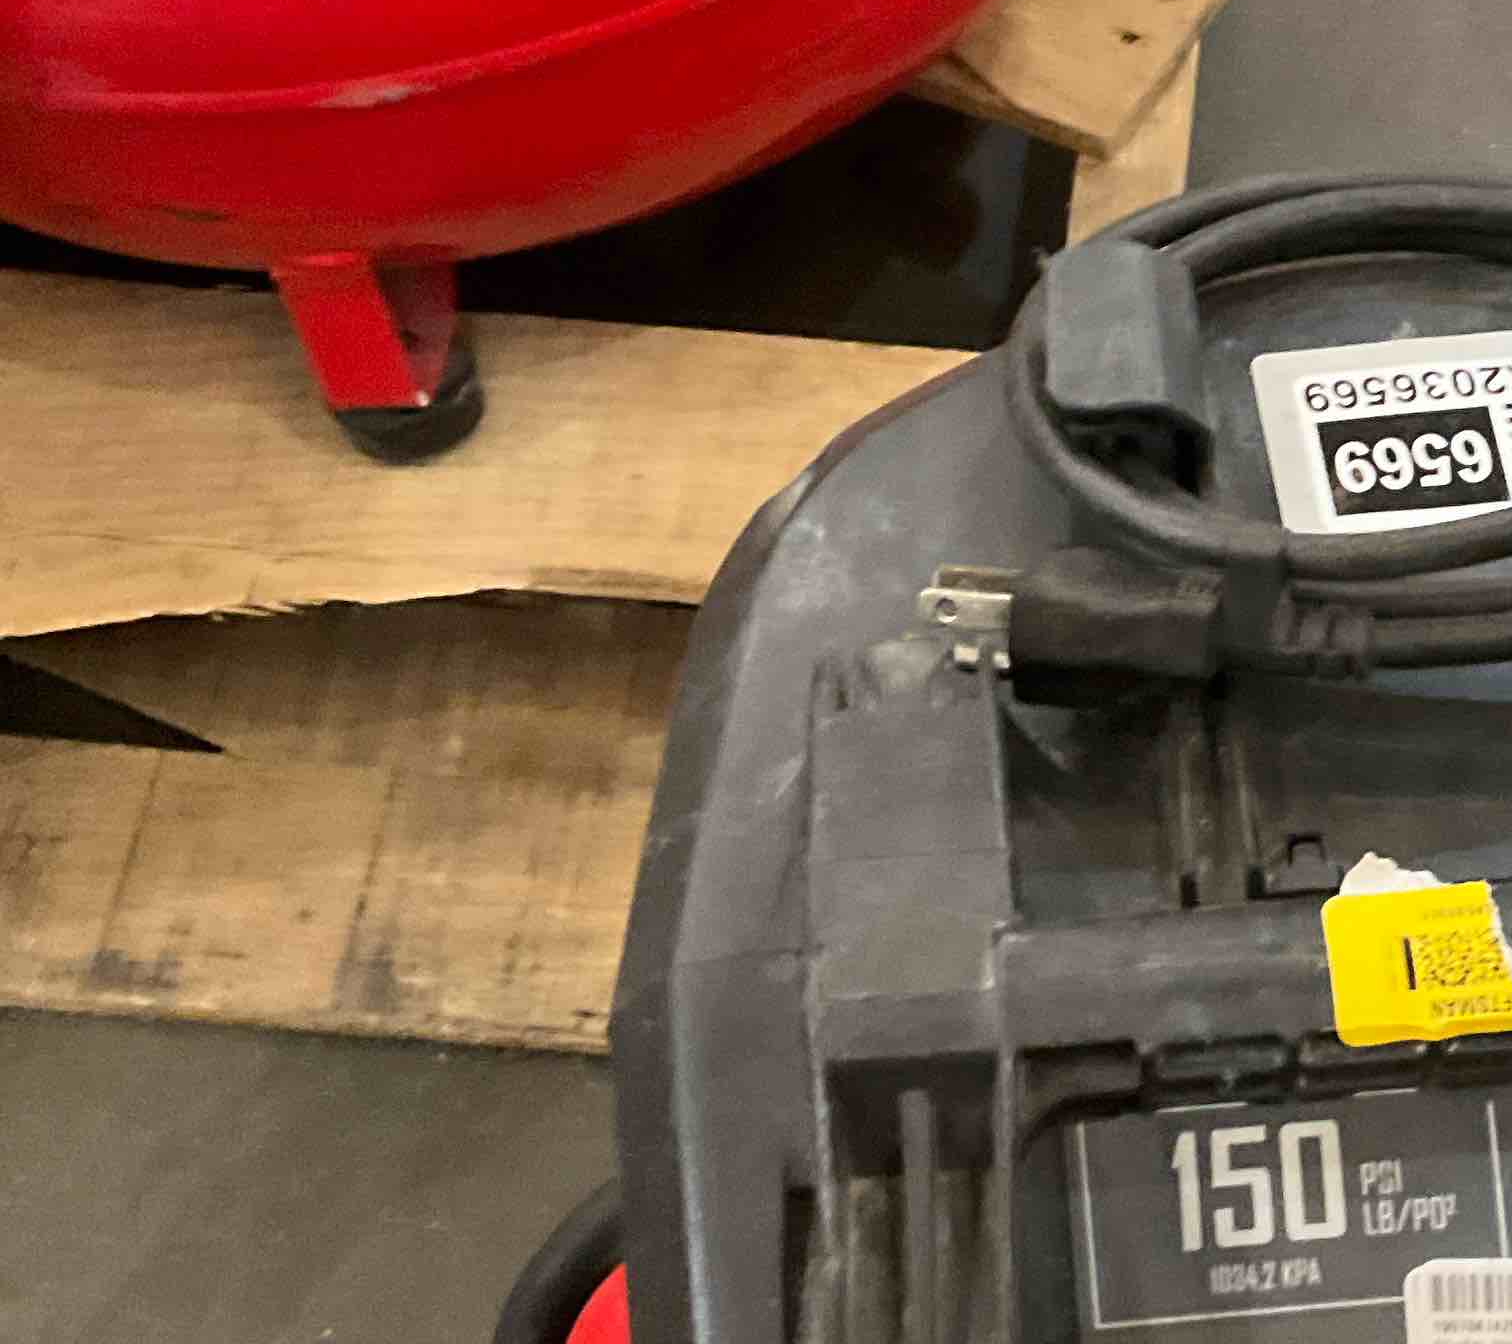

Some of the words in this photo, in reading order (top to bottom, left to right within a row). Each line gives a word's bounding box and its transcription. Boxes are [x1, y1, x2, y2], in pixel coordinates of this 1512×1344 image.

[1333, 428, 1494, 494] 6569
[1171, 1118, 1348, 1253] 150
[1358, 1158, 1404, 1197] PSI
[1280, 1256, 1323, 1287] KPA
